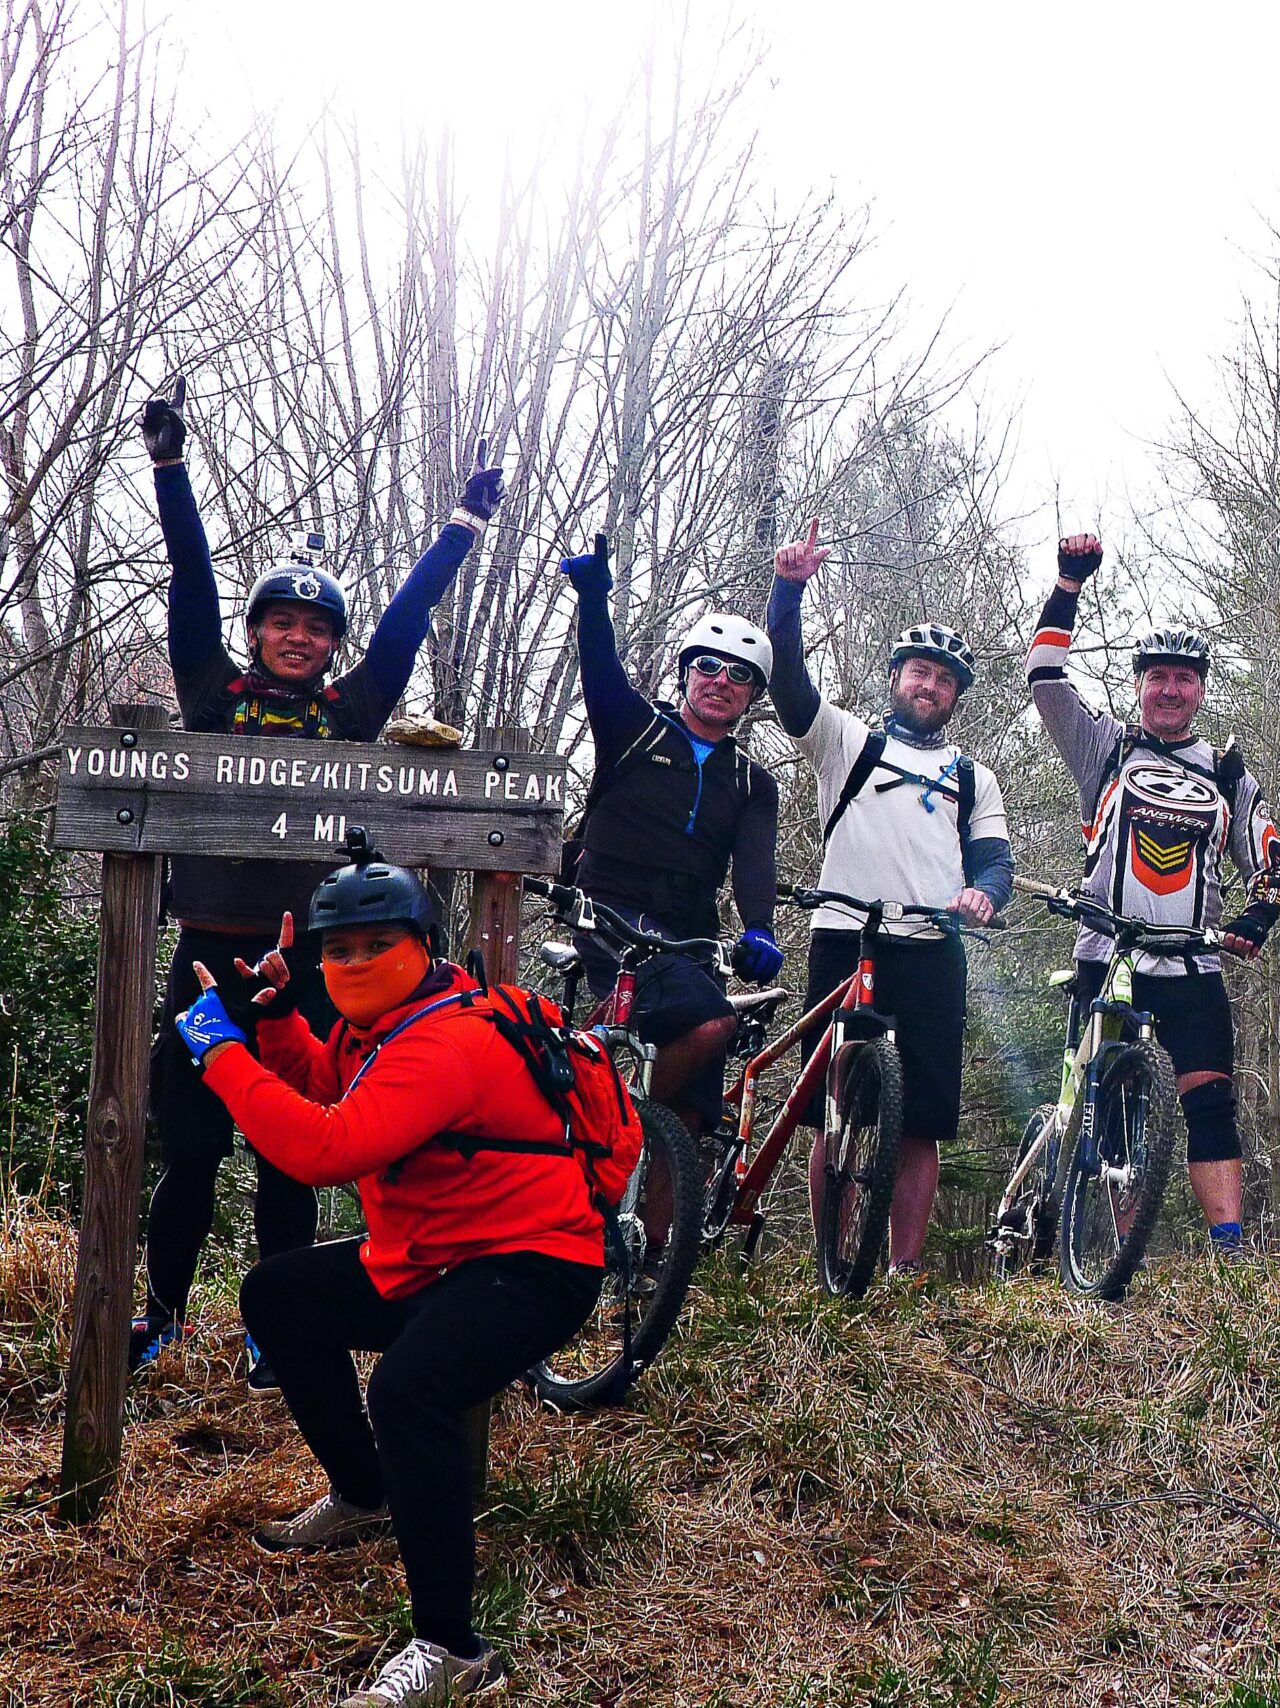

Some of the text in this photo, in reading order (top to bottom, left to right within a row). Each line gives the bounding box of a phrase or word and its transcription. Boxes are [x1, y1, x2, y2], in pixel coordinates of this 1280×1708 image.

[67, 747, 562, 802] YOUNGS RIDGE/KITSUMA PEAK
[271, 812, 346, 842] 4 MI
[1133, 807, 1208, 829] ANSWER
[1082, 1103, 1094, 1139] FOX
